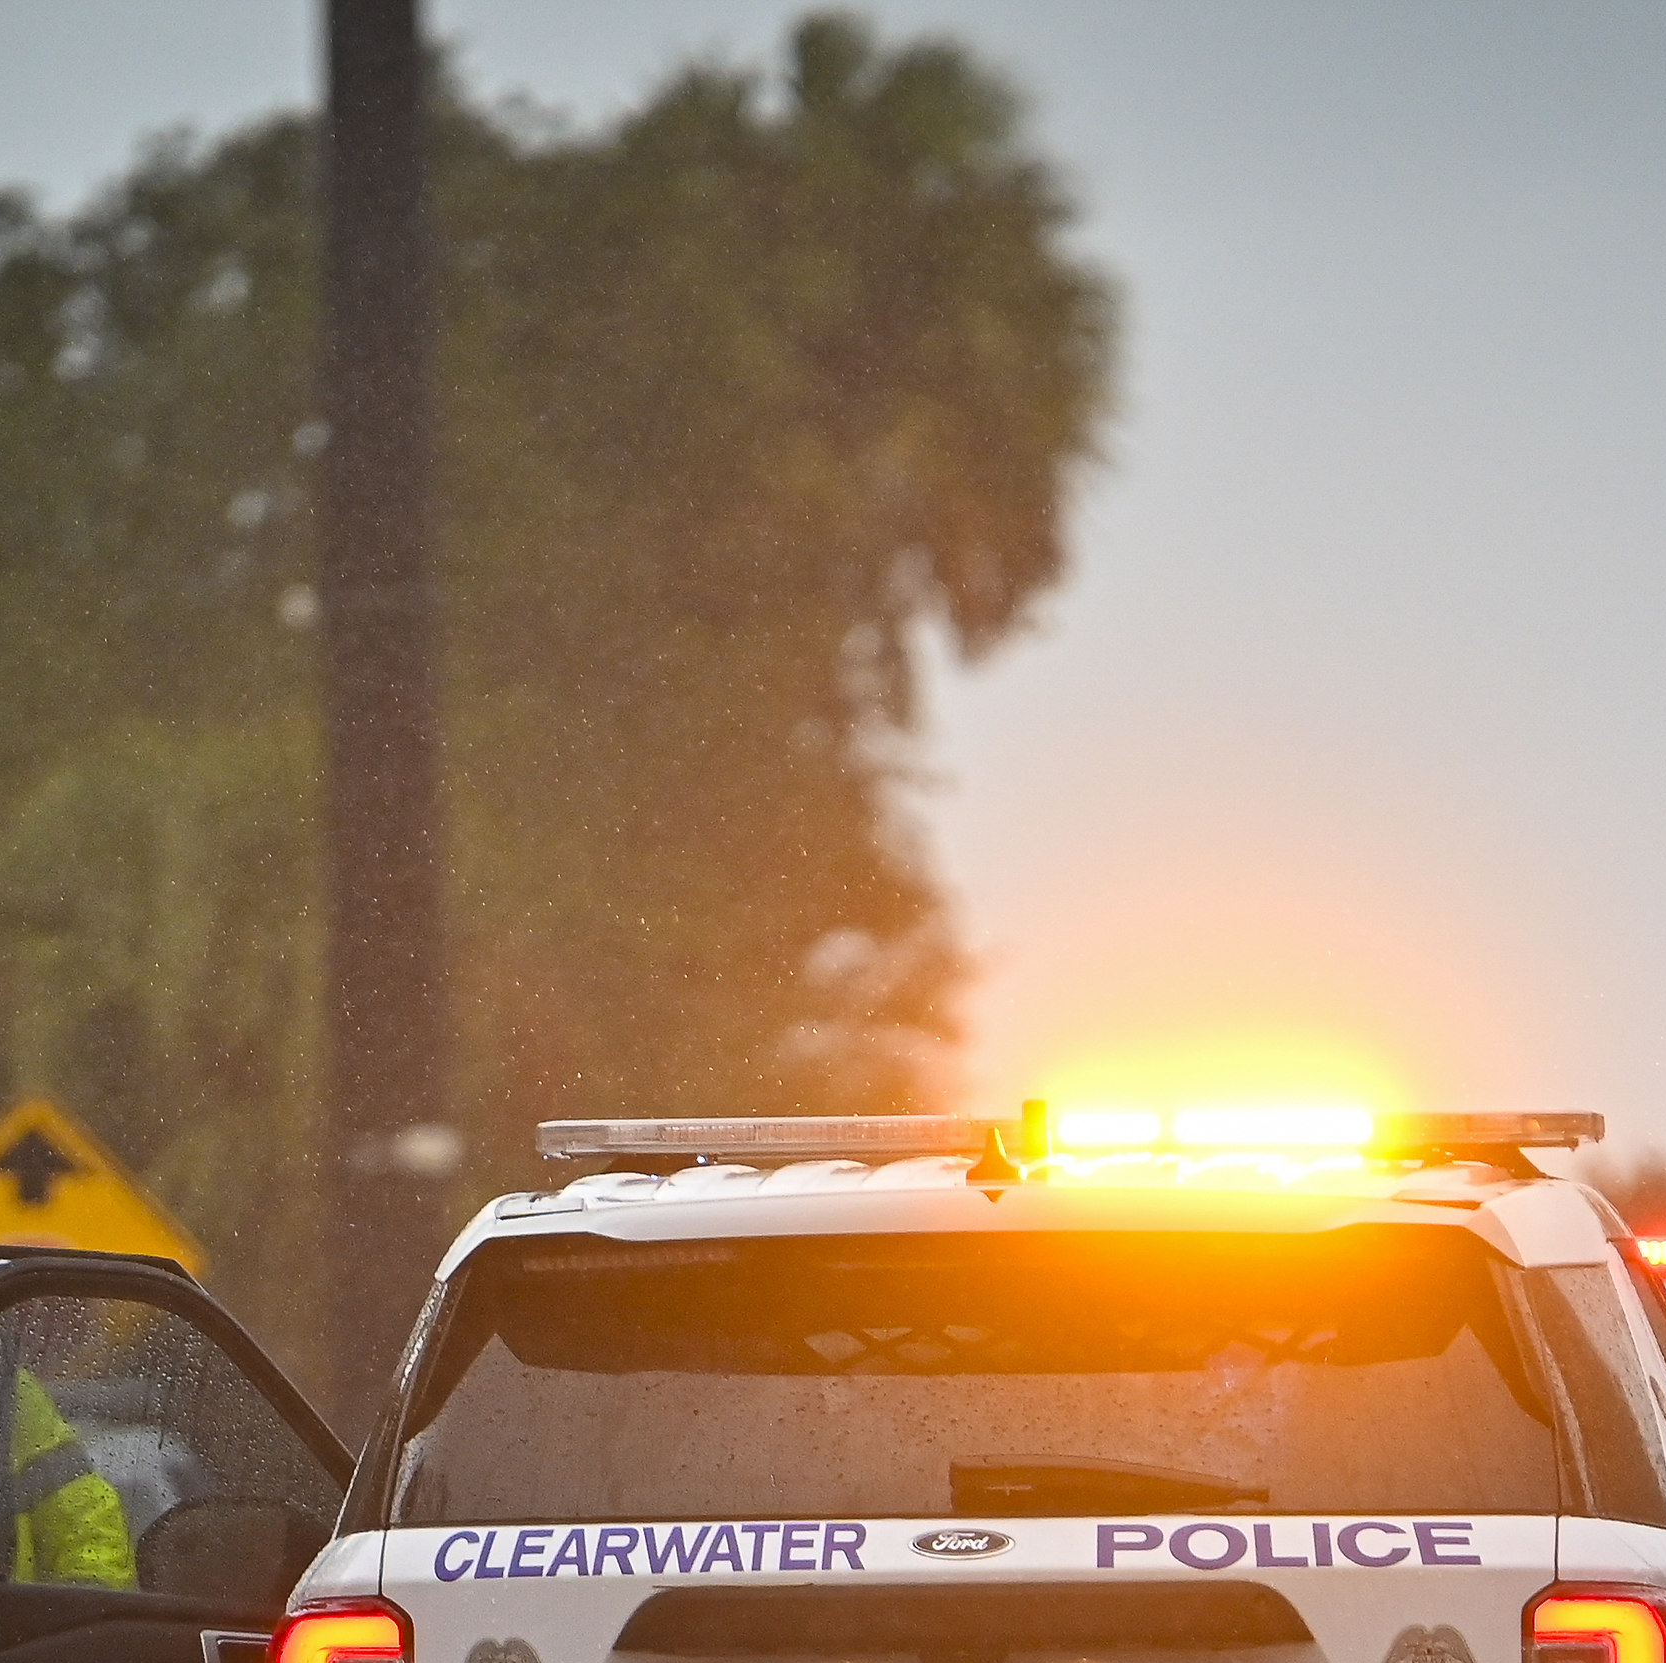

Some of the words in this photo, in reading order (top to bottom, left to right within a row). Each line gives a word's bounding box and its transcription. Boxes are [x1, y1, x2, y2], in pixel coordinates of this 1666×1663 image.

[433, 1522, 867, 1582] CLEARWATER
[932, 1531, 990, 1551] Ford
[1096, 1522, 1482, 1569] POLICE
